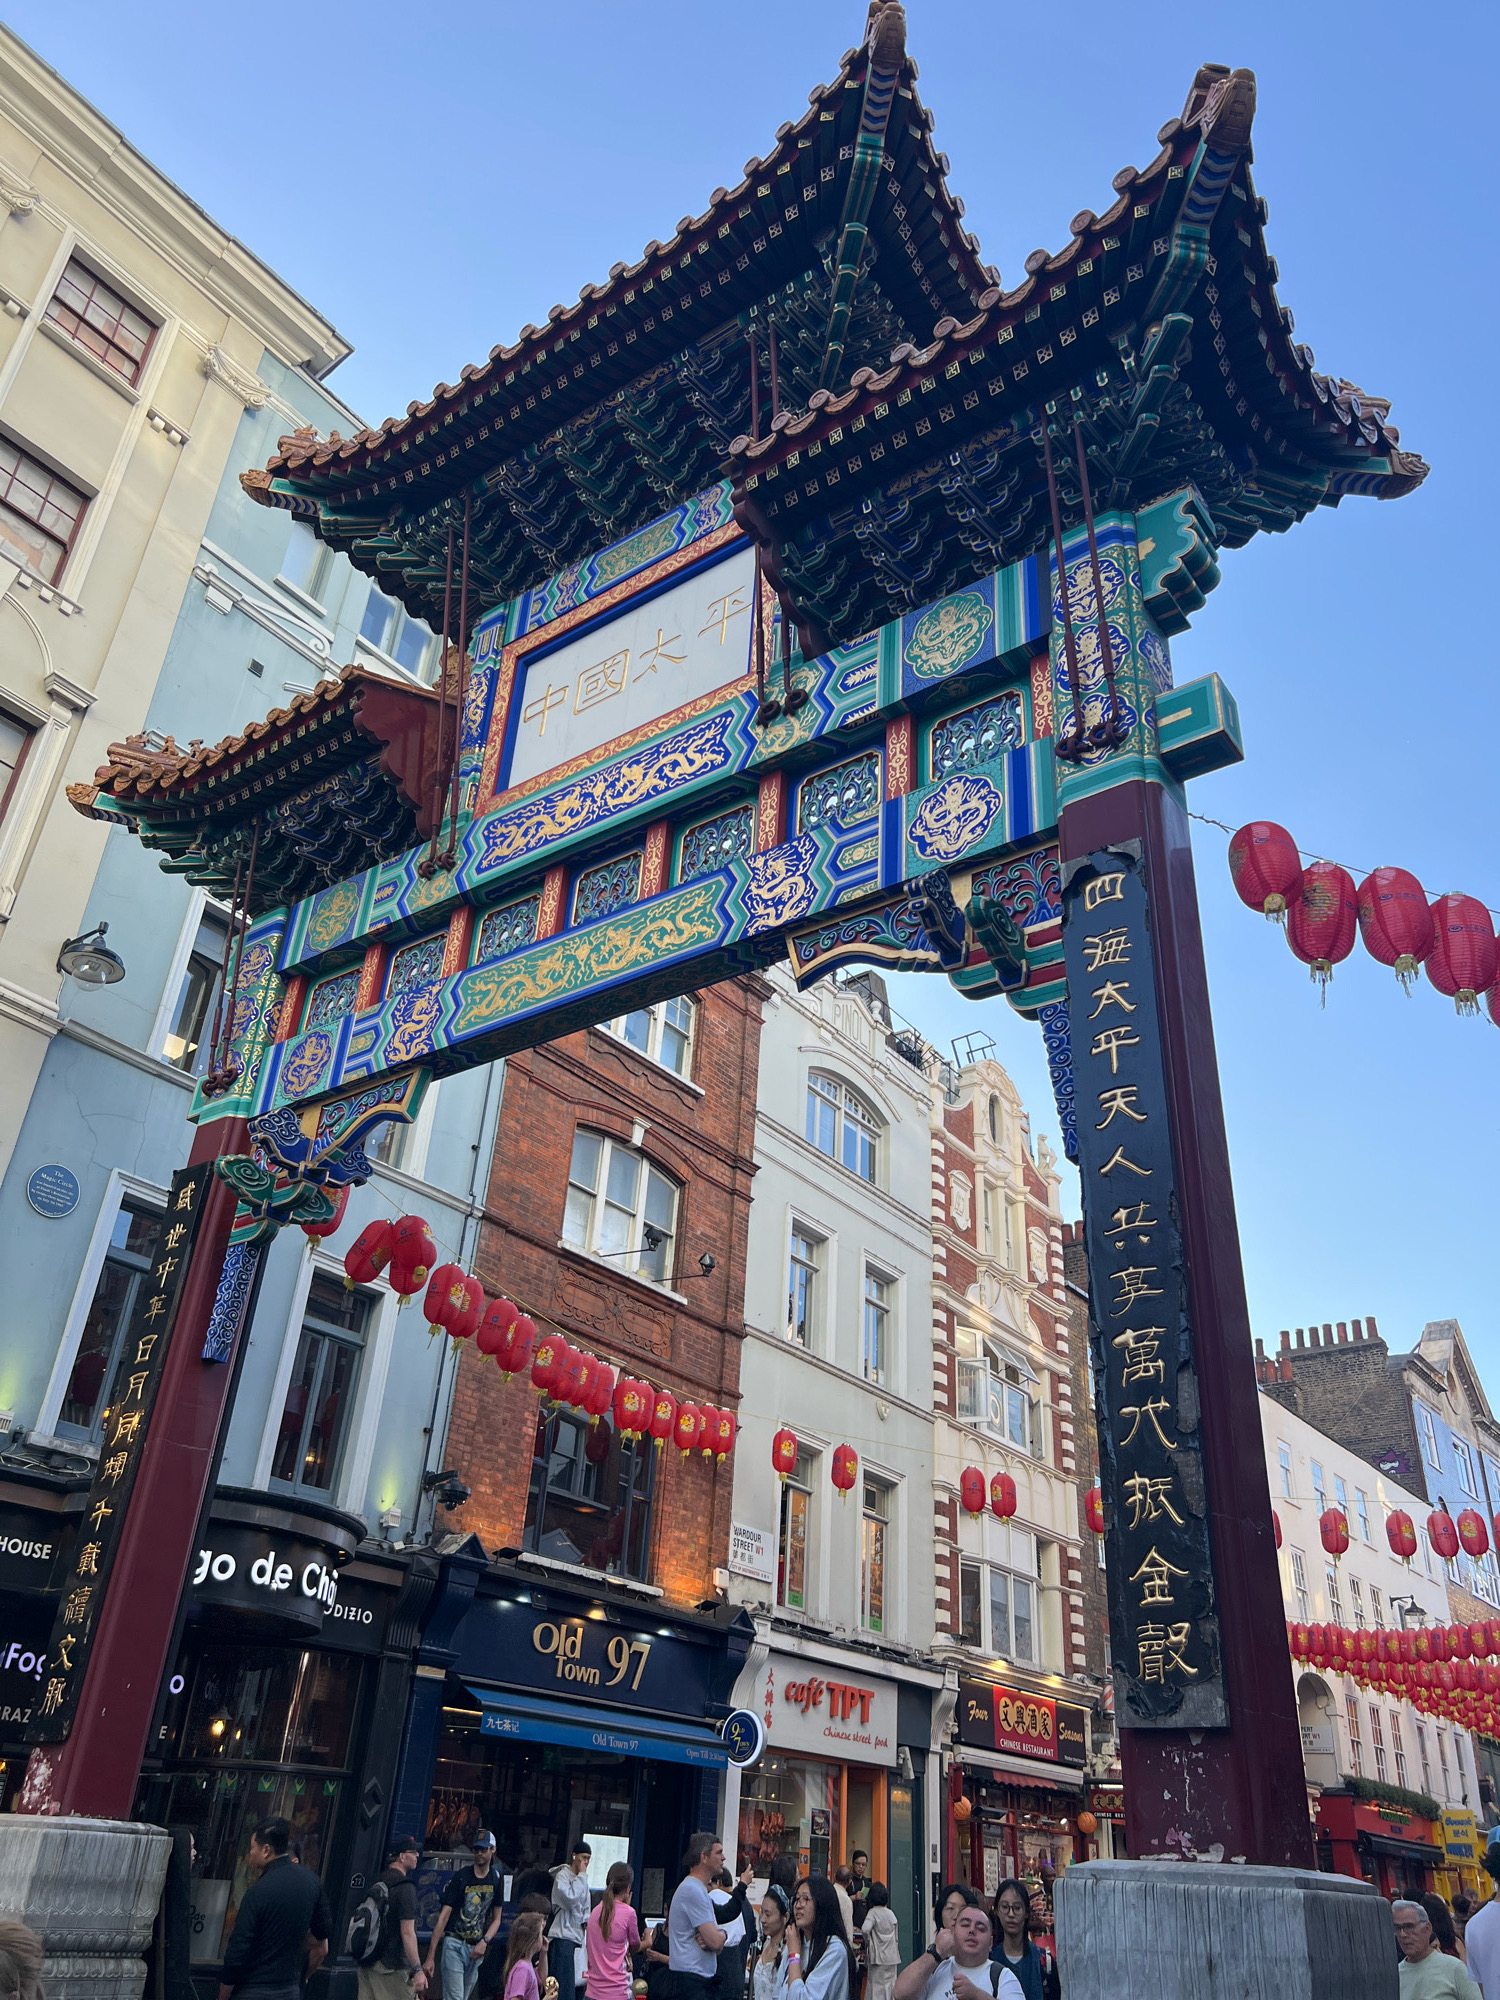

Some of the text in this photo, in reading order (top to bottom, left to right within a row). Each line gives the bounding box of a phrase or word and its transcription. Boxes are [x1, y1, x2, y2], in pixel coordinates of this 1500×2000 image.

[41, 1173, 57, 1183] Magic
[57, 1179, 74, 1189] Circle
[733, 1526, 762, 1544] WARDOUR
[733, 1537, 764, 1556] STREET W1
[251, 1551, 293, 1589] de
[533, 1622, 584, 1660] Old
[555, 1655, 600, 1685] Town
[605, 1636, 652, 1692] 97
[785, 1677, 875, 1724] café TPT
[968, 1700, 988, 1721] Four
[592, 1733, 639, 1751] Old Town 97
[823, 1726, 889, 1750] Chinese street food
[1058, 1722, 1083, 1743] Seasons
[686, 1748, 699, 1760] Open
[700, 1750, 708, 1758] Till
[1000, 1738, 1054, 1758] CHINESE RESTAURANT
